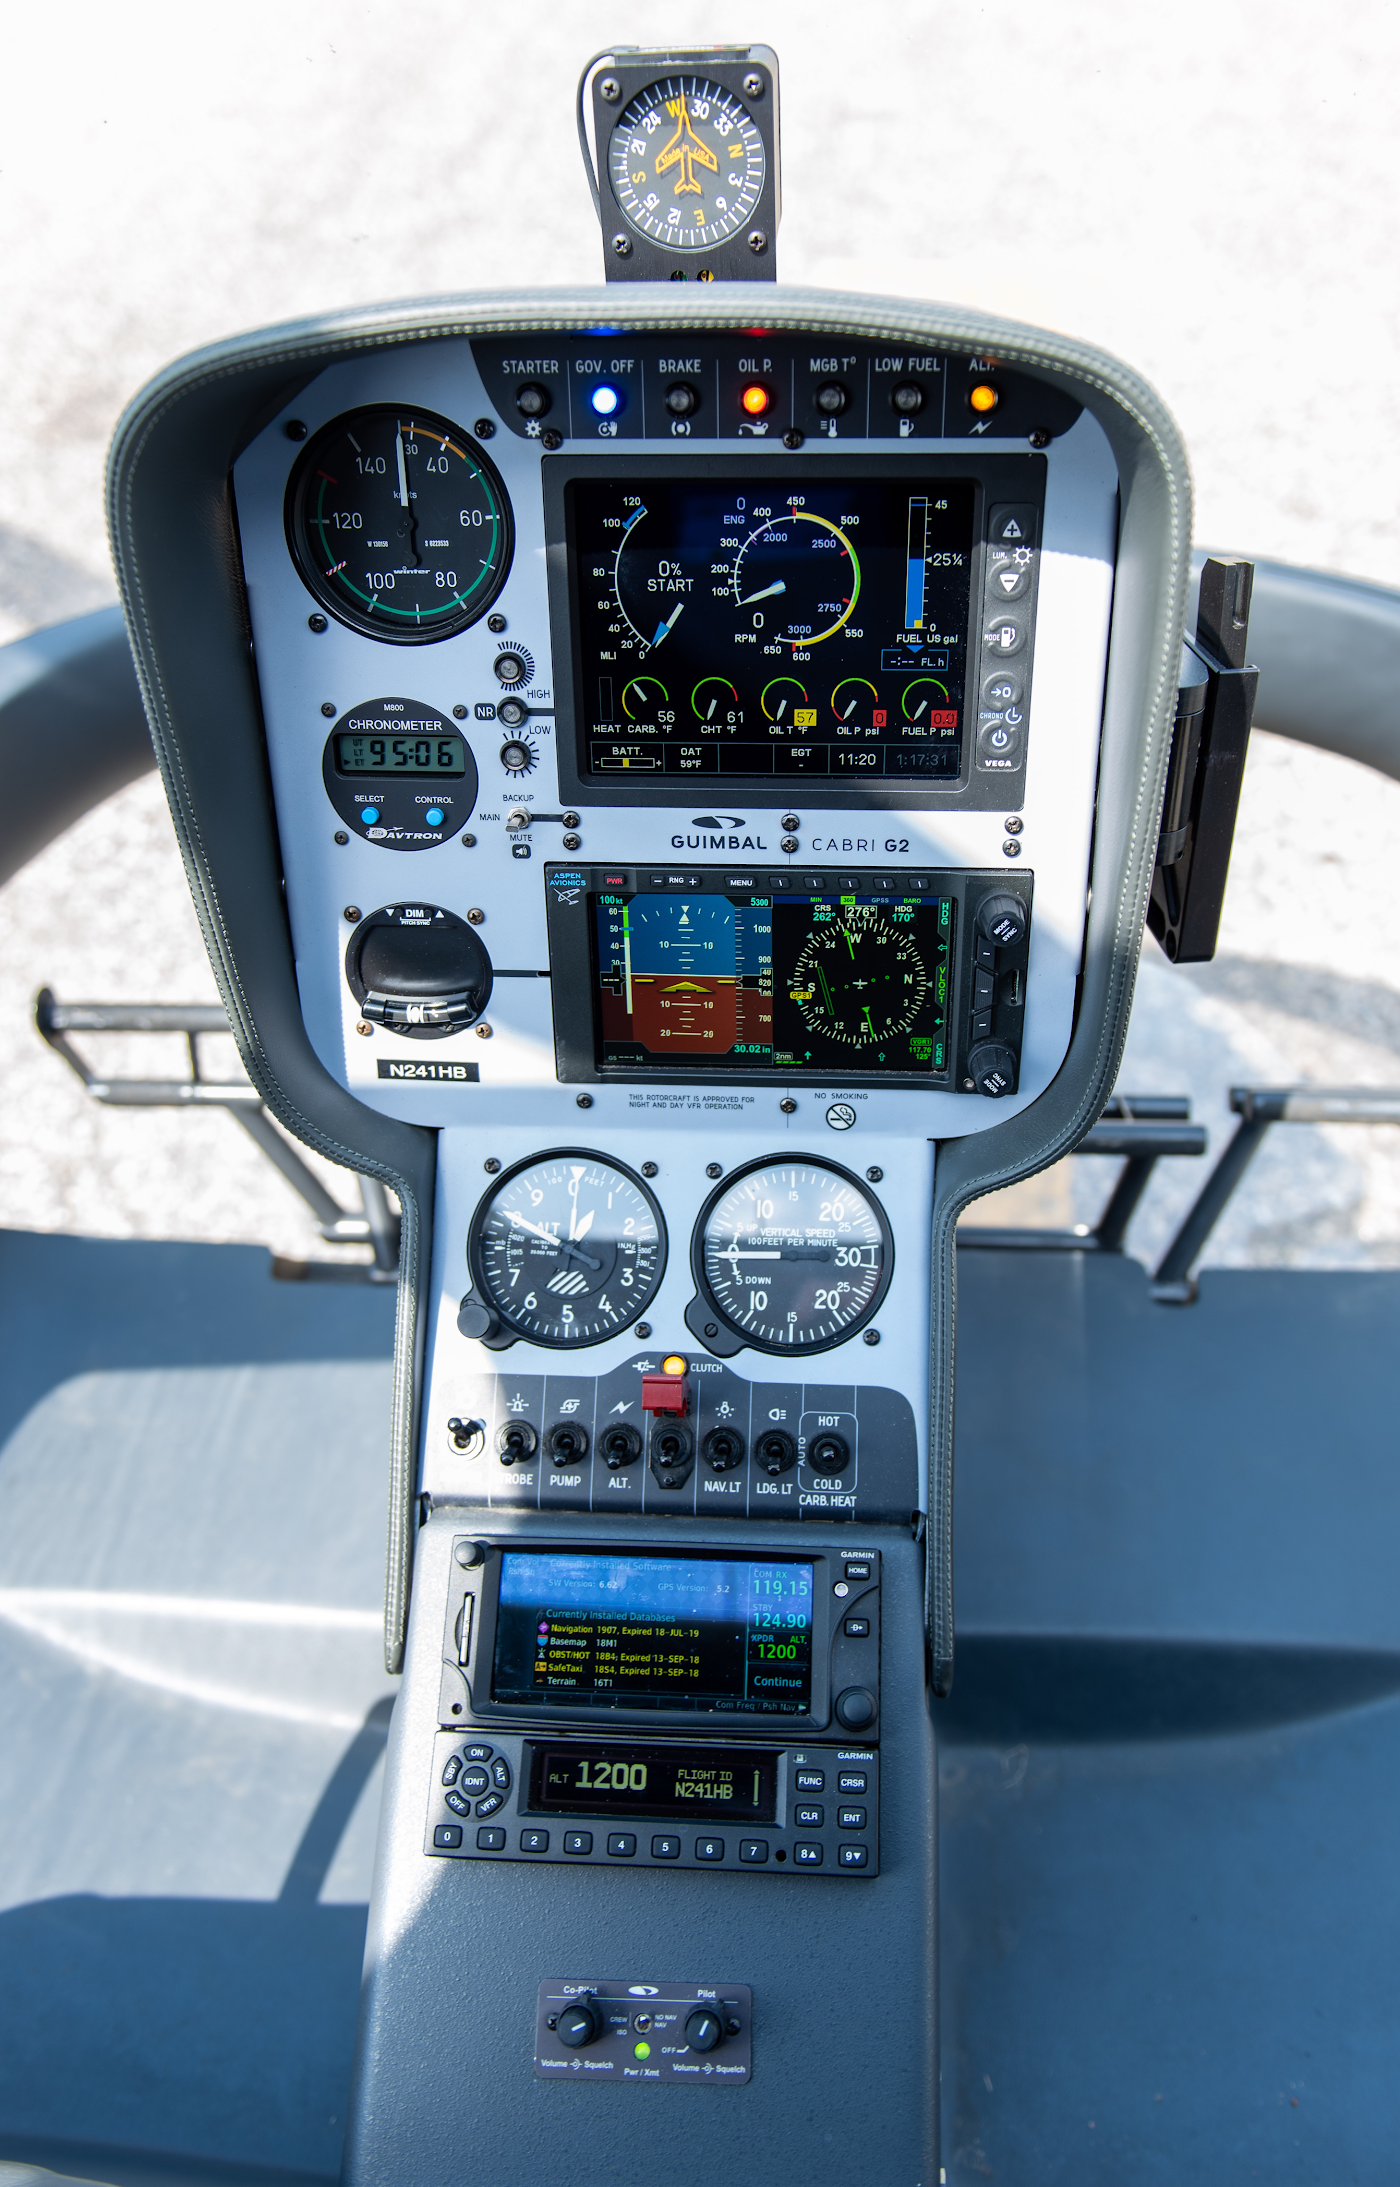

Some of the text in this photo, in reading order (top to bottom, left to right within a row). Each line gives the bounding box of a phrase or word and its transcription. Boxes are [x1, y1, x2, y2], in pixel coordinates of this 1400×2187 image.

[691, 99, 710, 119] 30
[713, 113, 734, 136] 33
[502, 360, 559, 374] STARTER
[575, 359, 634, 373] GOV. OFF
[659, 359, 701, 373] BRAKE
[738, 359, 772, 373] OIL P.
[810, 358, 838, 372] MGB
[875, 358, 941, 372] LOW FUEL
[355, 457, 387, 474] 140
[426, 457, 449, 474] 40
[787, 496, 805, 505] 450
[333, 512, 363, 529] 120
[459, 510, 482, 527] 60
[723, 515, 745, 525] ENG
[841, 516, 859, 525] 500
[763, 533, 788, 542] 2000
[812, 540, 836, 549] 2500
[365, 572, 395, 589] 100
[435, 571, 457, 587] 80
[647, 579, 694, 592] START
[818, 603, 842, 612] 2750
[788, 625, 811, 634] 3000
[735, 634, 756, 643] RPM
[896, 634, 958, 645] FUEL US gal
[600, 651, 617, 660] MLI
[527, 690, 550, 699] HIGH
[477, 707, 494, 717] NR
[349, 719, 442, 731] CHRONOMETER
[529, 726, 551, 735] LOW
[593, 725, 621, 733] HEAT
[627, 725, 658, 734] CARB.
[701, 726, 722, 734] CHT
[836, 726, 879, 737] OIL P psi
[902, 727, 954, 738] FUEL P psi
[370, 740, 453, 766] 95:06
[612, 747, 643, 755] BATT.
[681, 748, 702, 756] OAT
[791, 749, 812, 757] EGT
[680, 760, 701, 768] 59°F
[838, 753, 876, 766] 11:20
[985, 759, 1012, 767] VEGA
[354, 795, 384, 803] SELECT
[415, 796, 454, 804] CONTROL
[671, 835, 767, 850] GUIMBAL
[812, 838, 909, 852] CABRI G2
[599, 896, 614, 904] 100
[406, 910, 424, 918] DIM
[734, 1045, 761, 1053] 30.02
[389, 1065, 467, 1079] N241HB
[760, 1228, 835, 1238] VERTICAL SPEED
[787, 1238, 804, 1246] PER
[808, 1239, 838, 1247] MINUTE
[835, 1247, 861, 1267] 30
[690, 1363, 723, 1373] CLUTCH
[818, 1416, 839, 1426] HOT
[550, 1475, 581, 1487] PUMP
[609, 1478, 631, 1489] ALT.
[813, 1479, 842, 1490] COLD
[704, 1481, 741, 1493] NAV. LT
[757, 1483, 793, 1495] LDG. LT
[799, 1495, 856, 1507] CARB. HEAT
[841, 1551, 875, 1559] GARMIN
[753, 1580, 808, 1596] 119.15
[546, 1609, 676, 1622] Currently Installed Databases
[753, 1613, 807, 1628] 124.90
[551, 1624, 593, 1634] Navigation
[622, 1627, 652, 1636] Expired
[550, 1637, 617, 1647] Basemap 18M1
[758, 1644, 796, 1659] 1200
[548, 1664, 583, 1672] SafeTaxi
[547, 1677, 576, 1685] Terrain
[753, 1676, 802, 1687] Continue
[838, 1752, 873, 1760] GARMIN
[575, 1761, 647, 1790] 1200
[678, 1769, 732, 1781] FLIGHT ID
[465, 1777, 484, 1785] IDNT
[799, 1777, 822, 1785] FUNC
[841, 1779, 864, 1787] CRSR
[675, 1782, 733, 1799] N241HB
[801, 1812, 818, 1820] CLR
[844, 1814, 861, 1822] ENT
[697, 1990, 716, 1998] Pilot
[541, 2059, 613, 2070] Volume Squelch
[673, 2064, 745, 2074] Volume Squelch
